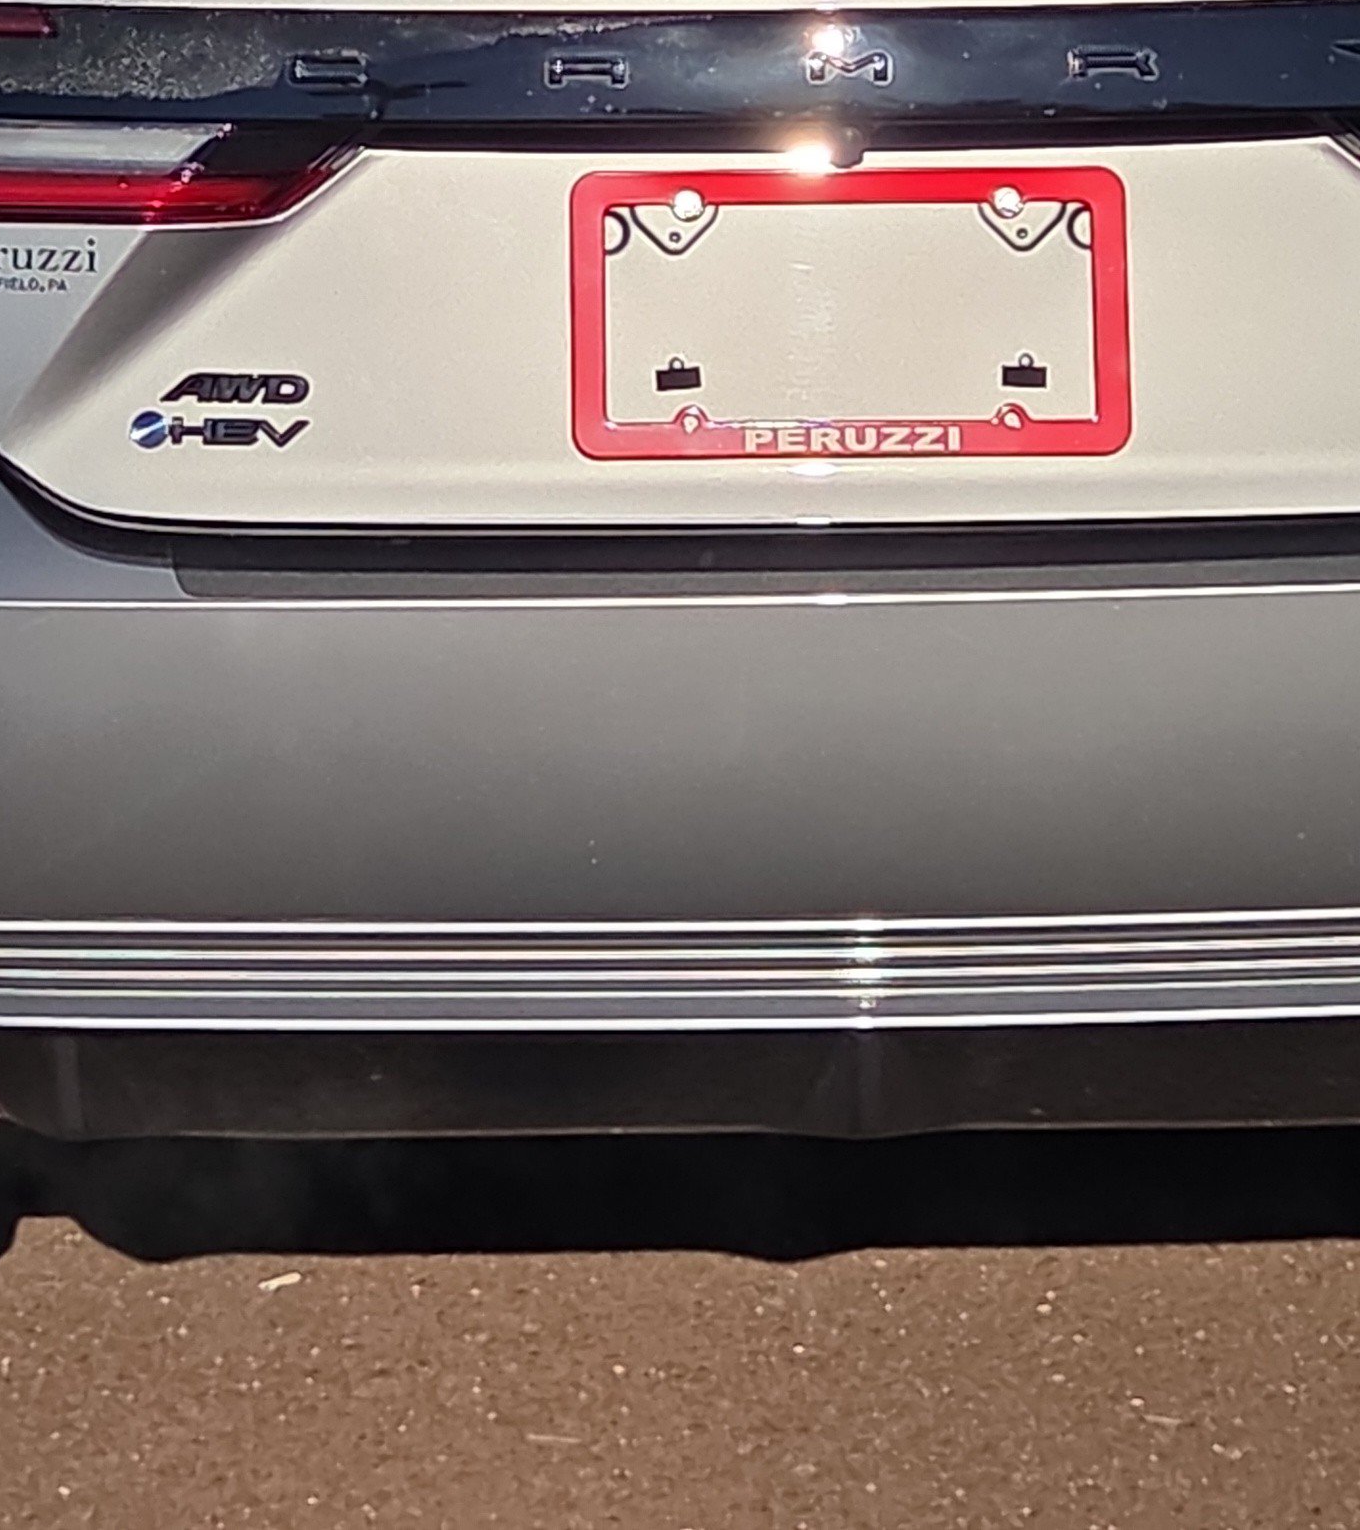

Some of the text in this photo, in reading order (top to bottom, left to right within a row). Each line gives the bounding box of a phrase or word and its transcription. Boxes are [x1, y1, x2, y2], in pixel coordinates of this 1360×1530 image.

[159, 372, 310, 405] AWD
[169, 416, 311, 449] HEV
[743, 426, 963, 454] PERUZZI
